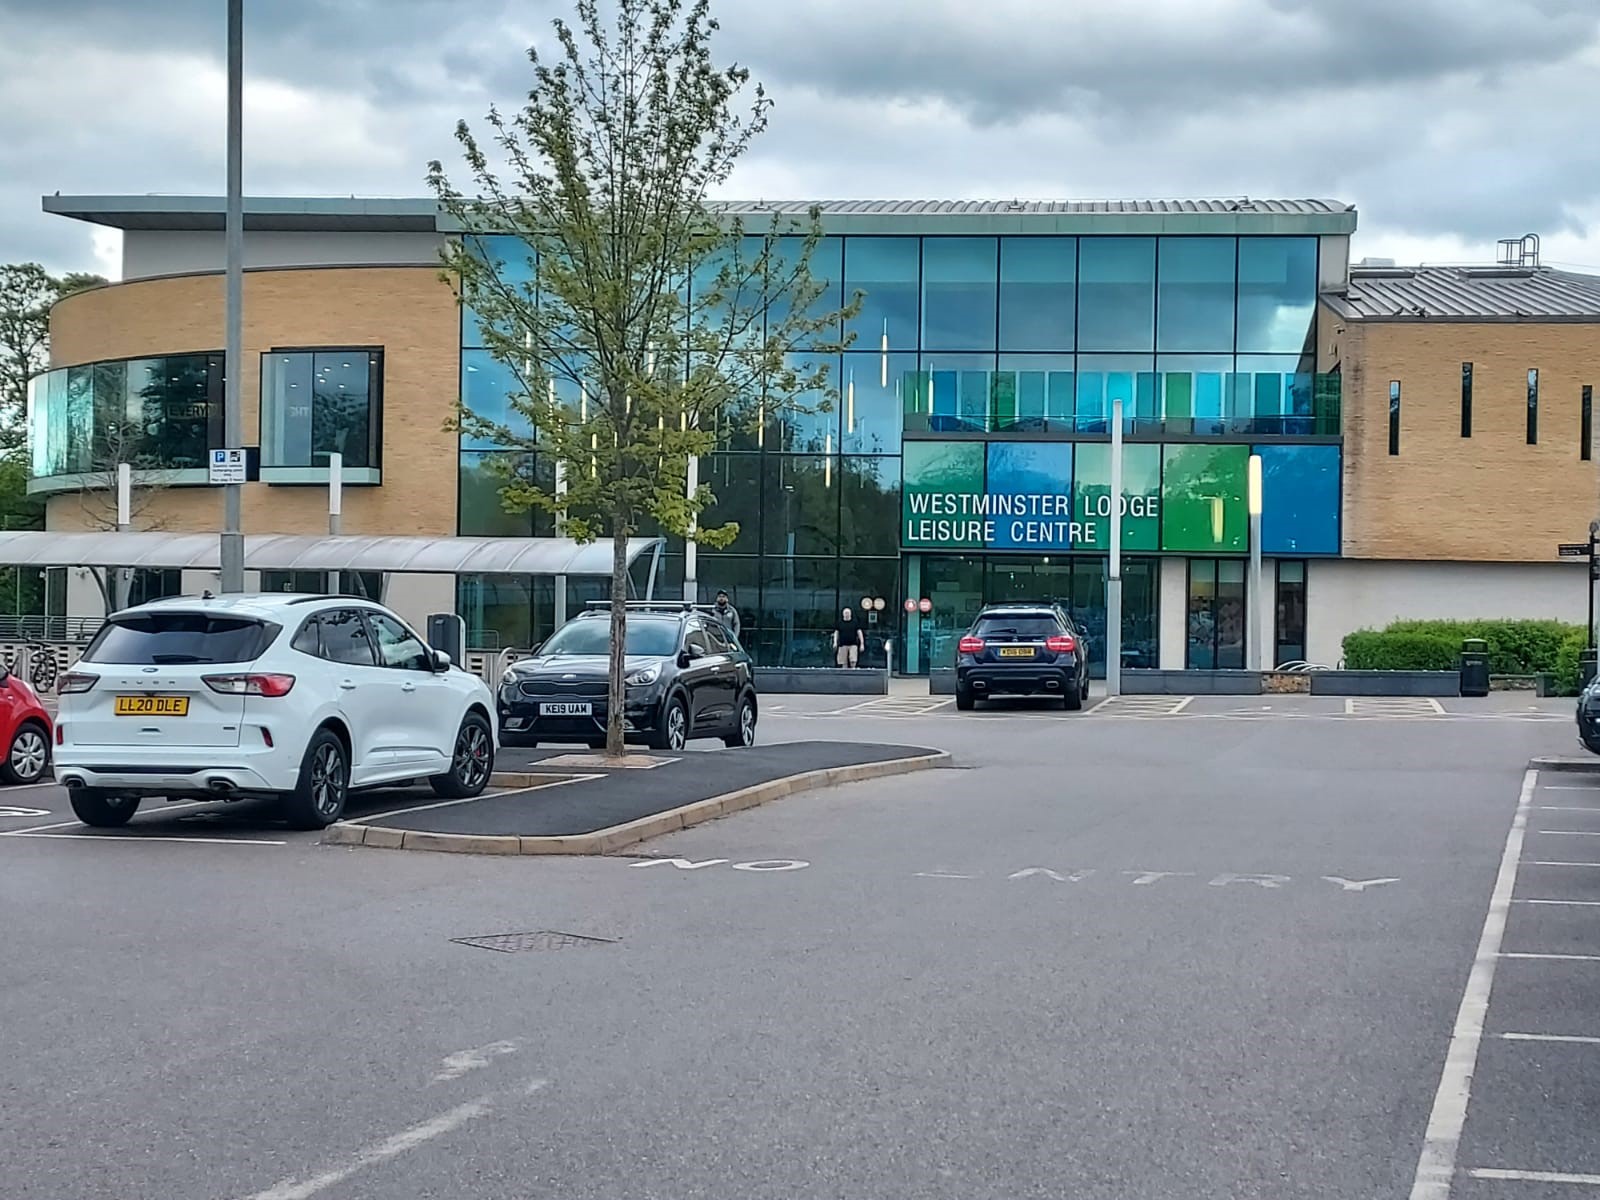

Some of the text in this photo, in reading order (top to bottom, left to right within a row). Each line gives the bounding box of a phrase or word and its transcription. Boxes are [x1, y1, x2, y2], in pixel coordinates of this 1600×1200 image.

[909, 493, 1069, 516] WESTMINSTER
[908, 519, 1097, 543] LEISURE CENTRE
[119, 698, 183, 712] LL20 DLE
[545, 704, 567, 714] KE19
[628, 858, 810, 871] NO
